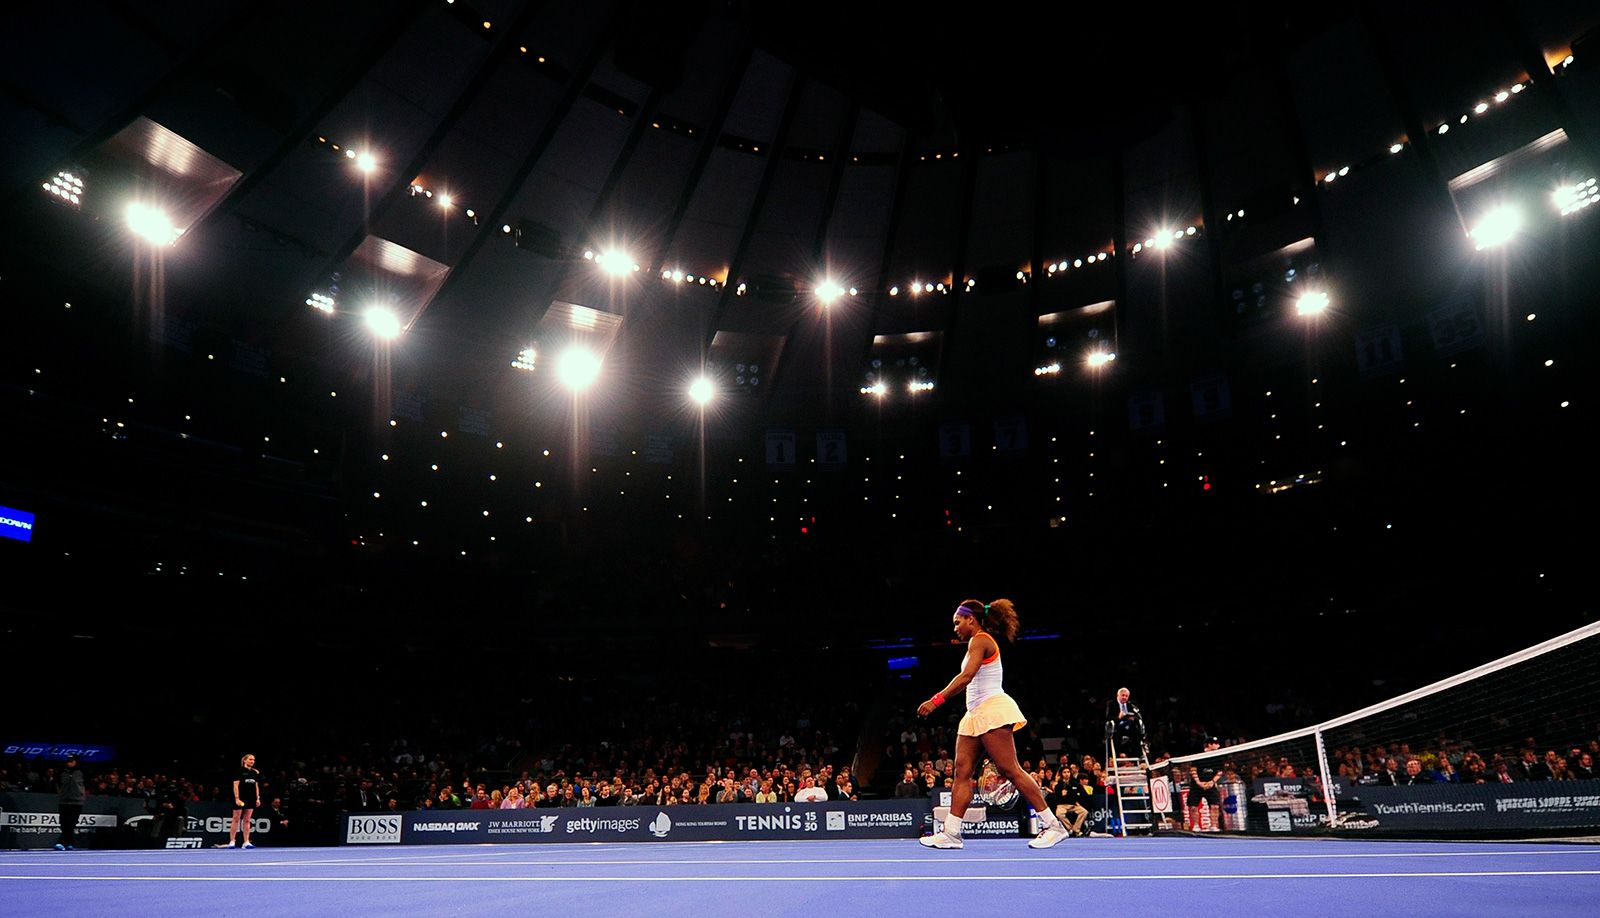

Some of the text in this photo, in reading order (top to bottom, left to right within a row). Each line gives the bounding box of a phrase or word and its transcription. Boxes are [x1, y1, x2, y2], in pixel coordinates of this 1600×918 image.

[1374, 802, 1486, 815] YouthTennis.com
[8, 814, 37, 824] BNP
[804, 812, 817, 821] 15
[847, 813, 913, 822] BNP PARIBAS
[205, 817, 271, 833] GEICO
[351, 818, 398, 834] BOSS
[413, 822, 480, 833] NASDAQ OMX
[501, 820, 541, 828] MARRIOTT
[566, 818, 639, 833] gettyimages
[804, 821, 818, 832] 30
[977, 820, 1019, 829] PARIBAS
[166, 838, 203, 849] ESPN
